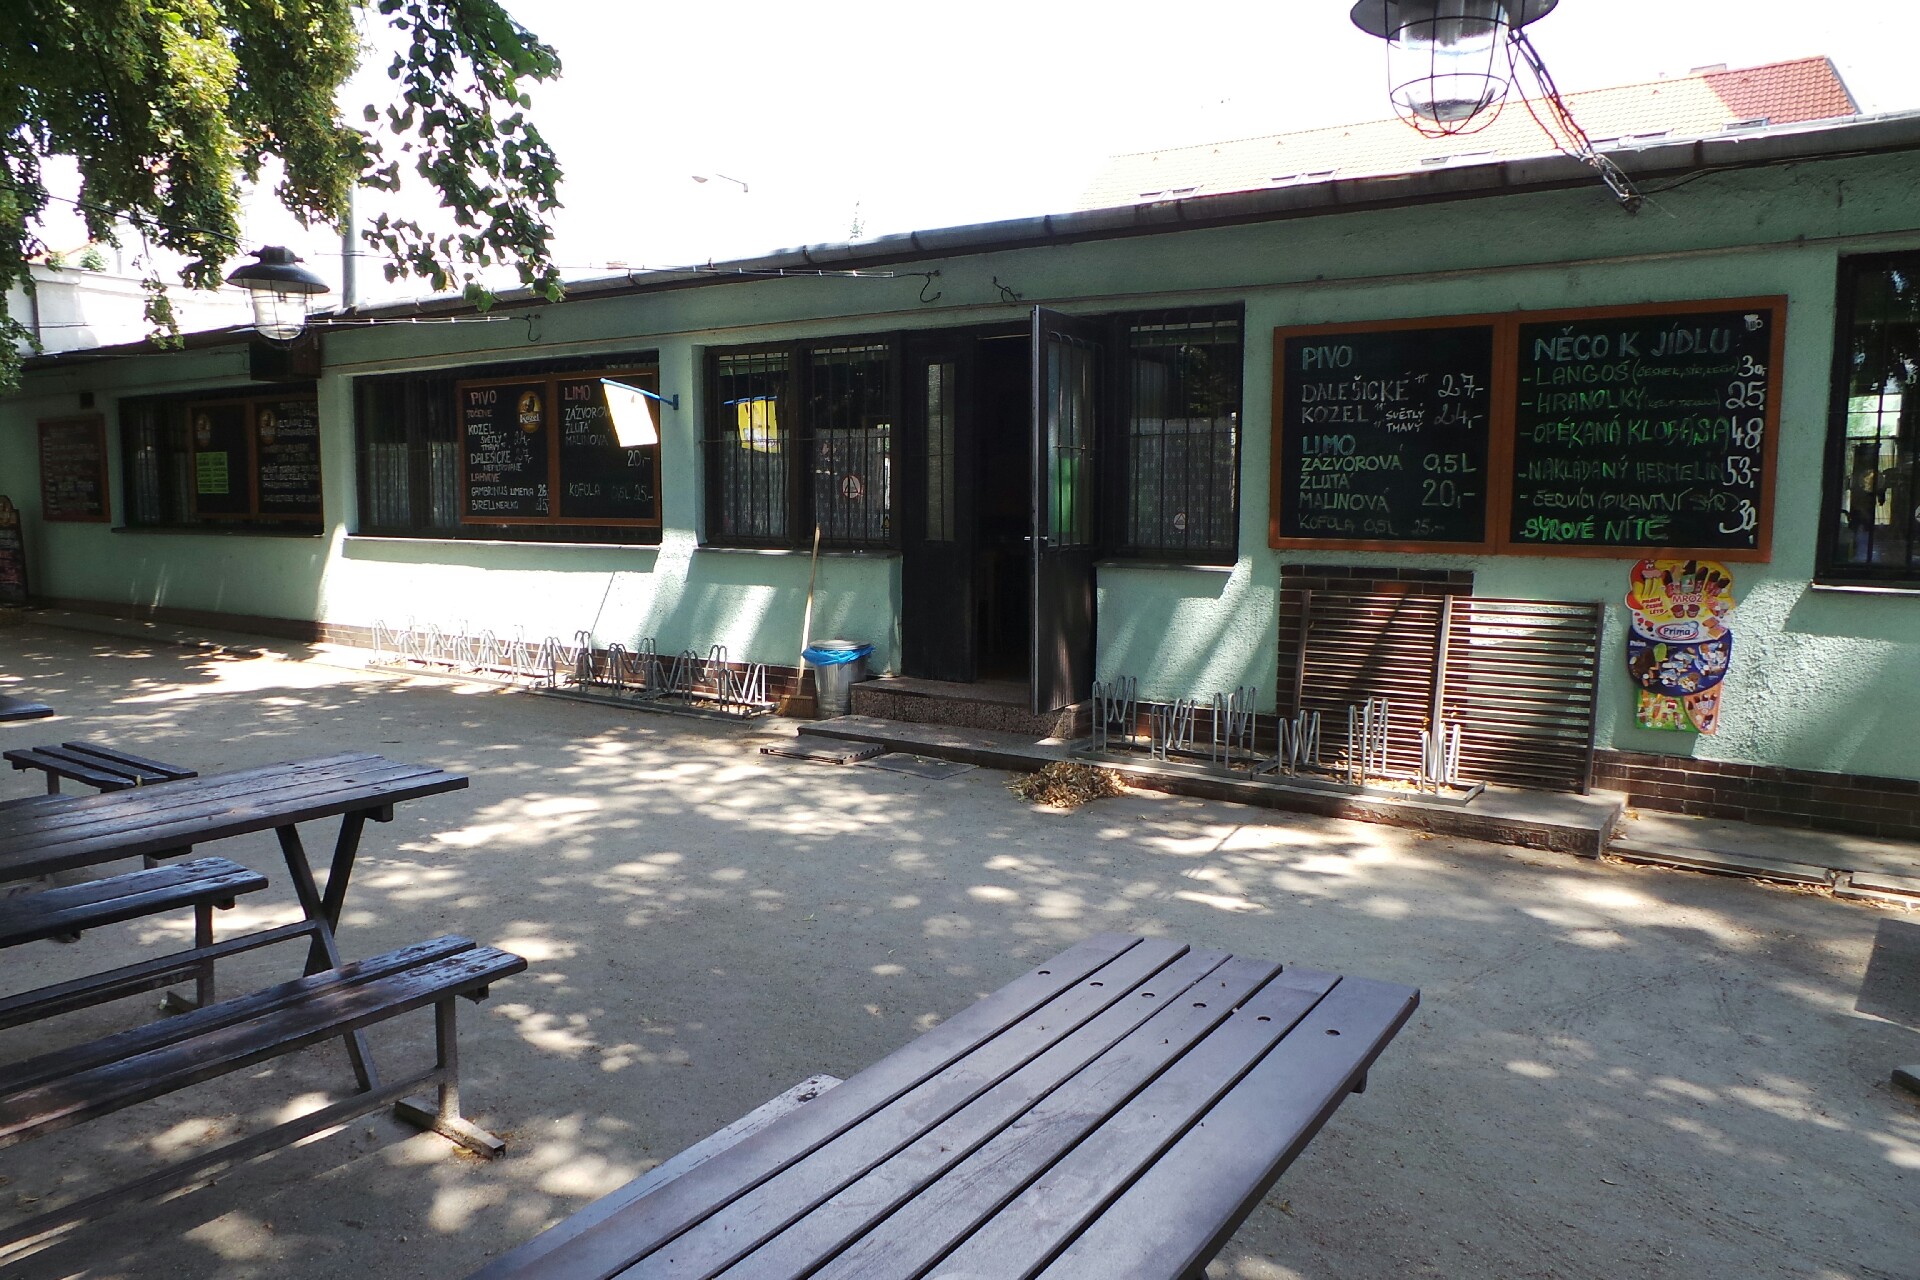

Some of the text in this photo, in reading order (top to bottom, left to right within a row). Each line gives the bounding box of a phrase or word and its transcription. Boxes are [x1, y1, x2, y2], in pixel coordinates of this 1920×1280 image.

[1534, 325, 1610, 361] NĚCO
[1619, 331, 1640, 357] K
[1302, 345, 1353, 371] PIVO
[470, 390, 497, 406] PIVO
[565, 385, 590, 401] LIMO
[1302, 404, 1369, 424] KOZEL
[468, 423, 495, 436] KOZEL
[1302, 434, 1357, 456] LIMO
[1421, 478, 1477, 509] 20,-
[1298, 513, 1355, 534] KOFOLA
[1663, 626, 1691, 637] Prima
